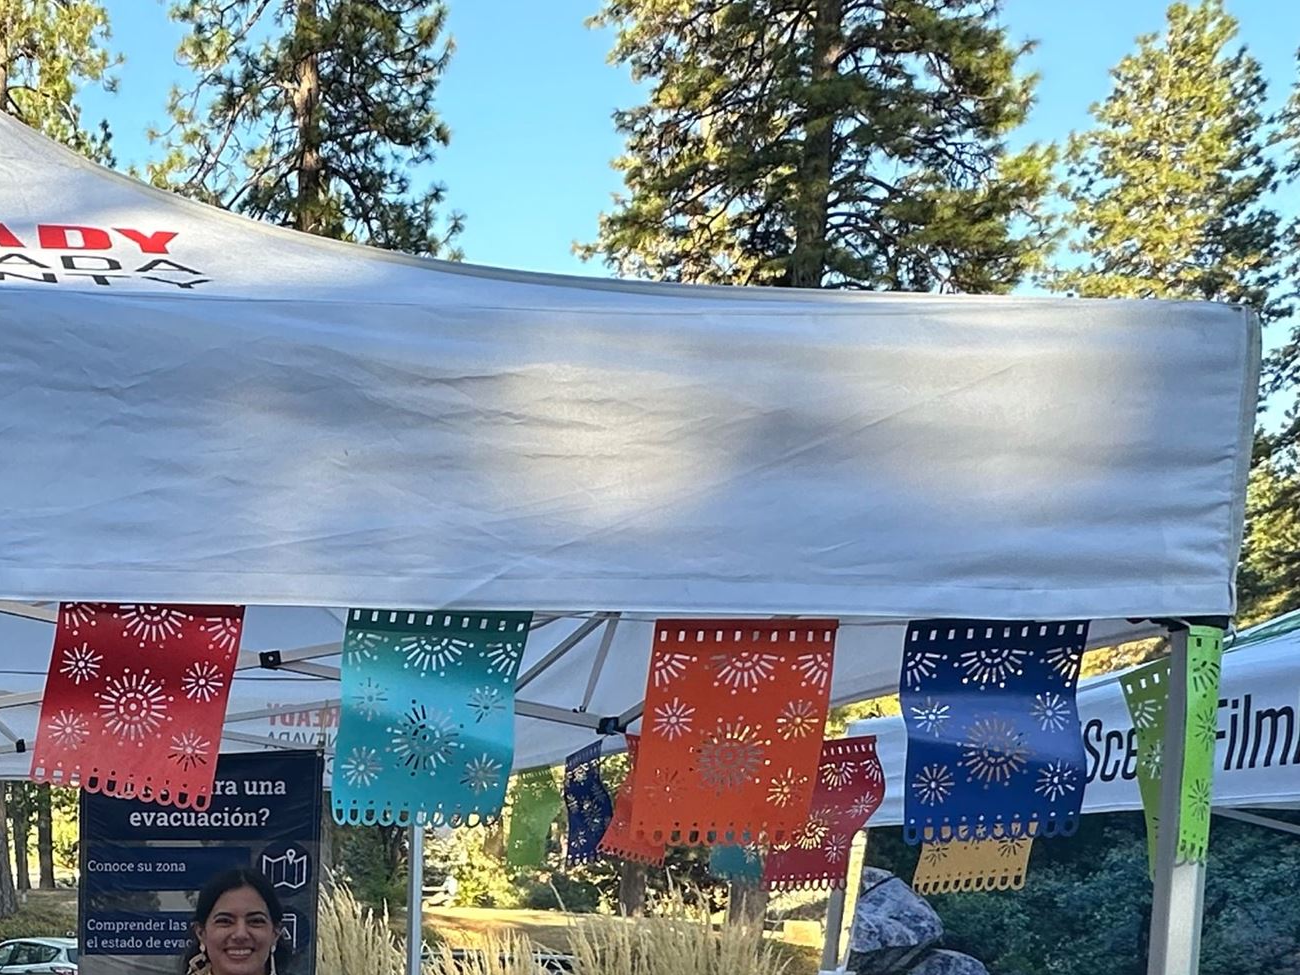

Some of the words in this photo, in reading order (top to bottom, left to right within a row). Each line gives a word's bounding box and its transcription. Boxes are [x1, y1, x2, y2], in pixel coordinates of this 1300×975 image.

[1083, 719, 1137, 784] Sce
[211, 781, 238, 795] ra
[244, 781, 286, 796] una
[129, 807, 270, 827] evacuación?
[87, 860, 134, 872] Conoce
[137, 863, 152, 872] su
[156, 862, 186, 872] zona
[87, 919, 165, 933] Comprender
[169, 919, 187, 931] las
[86, 938, 98, 948] el
[101, 937, 143, 948] estado
[145, 937, 161, 948] de
[164, 939, 193, 949] evac
